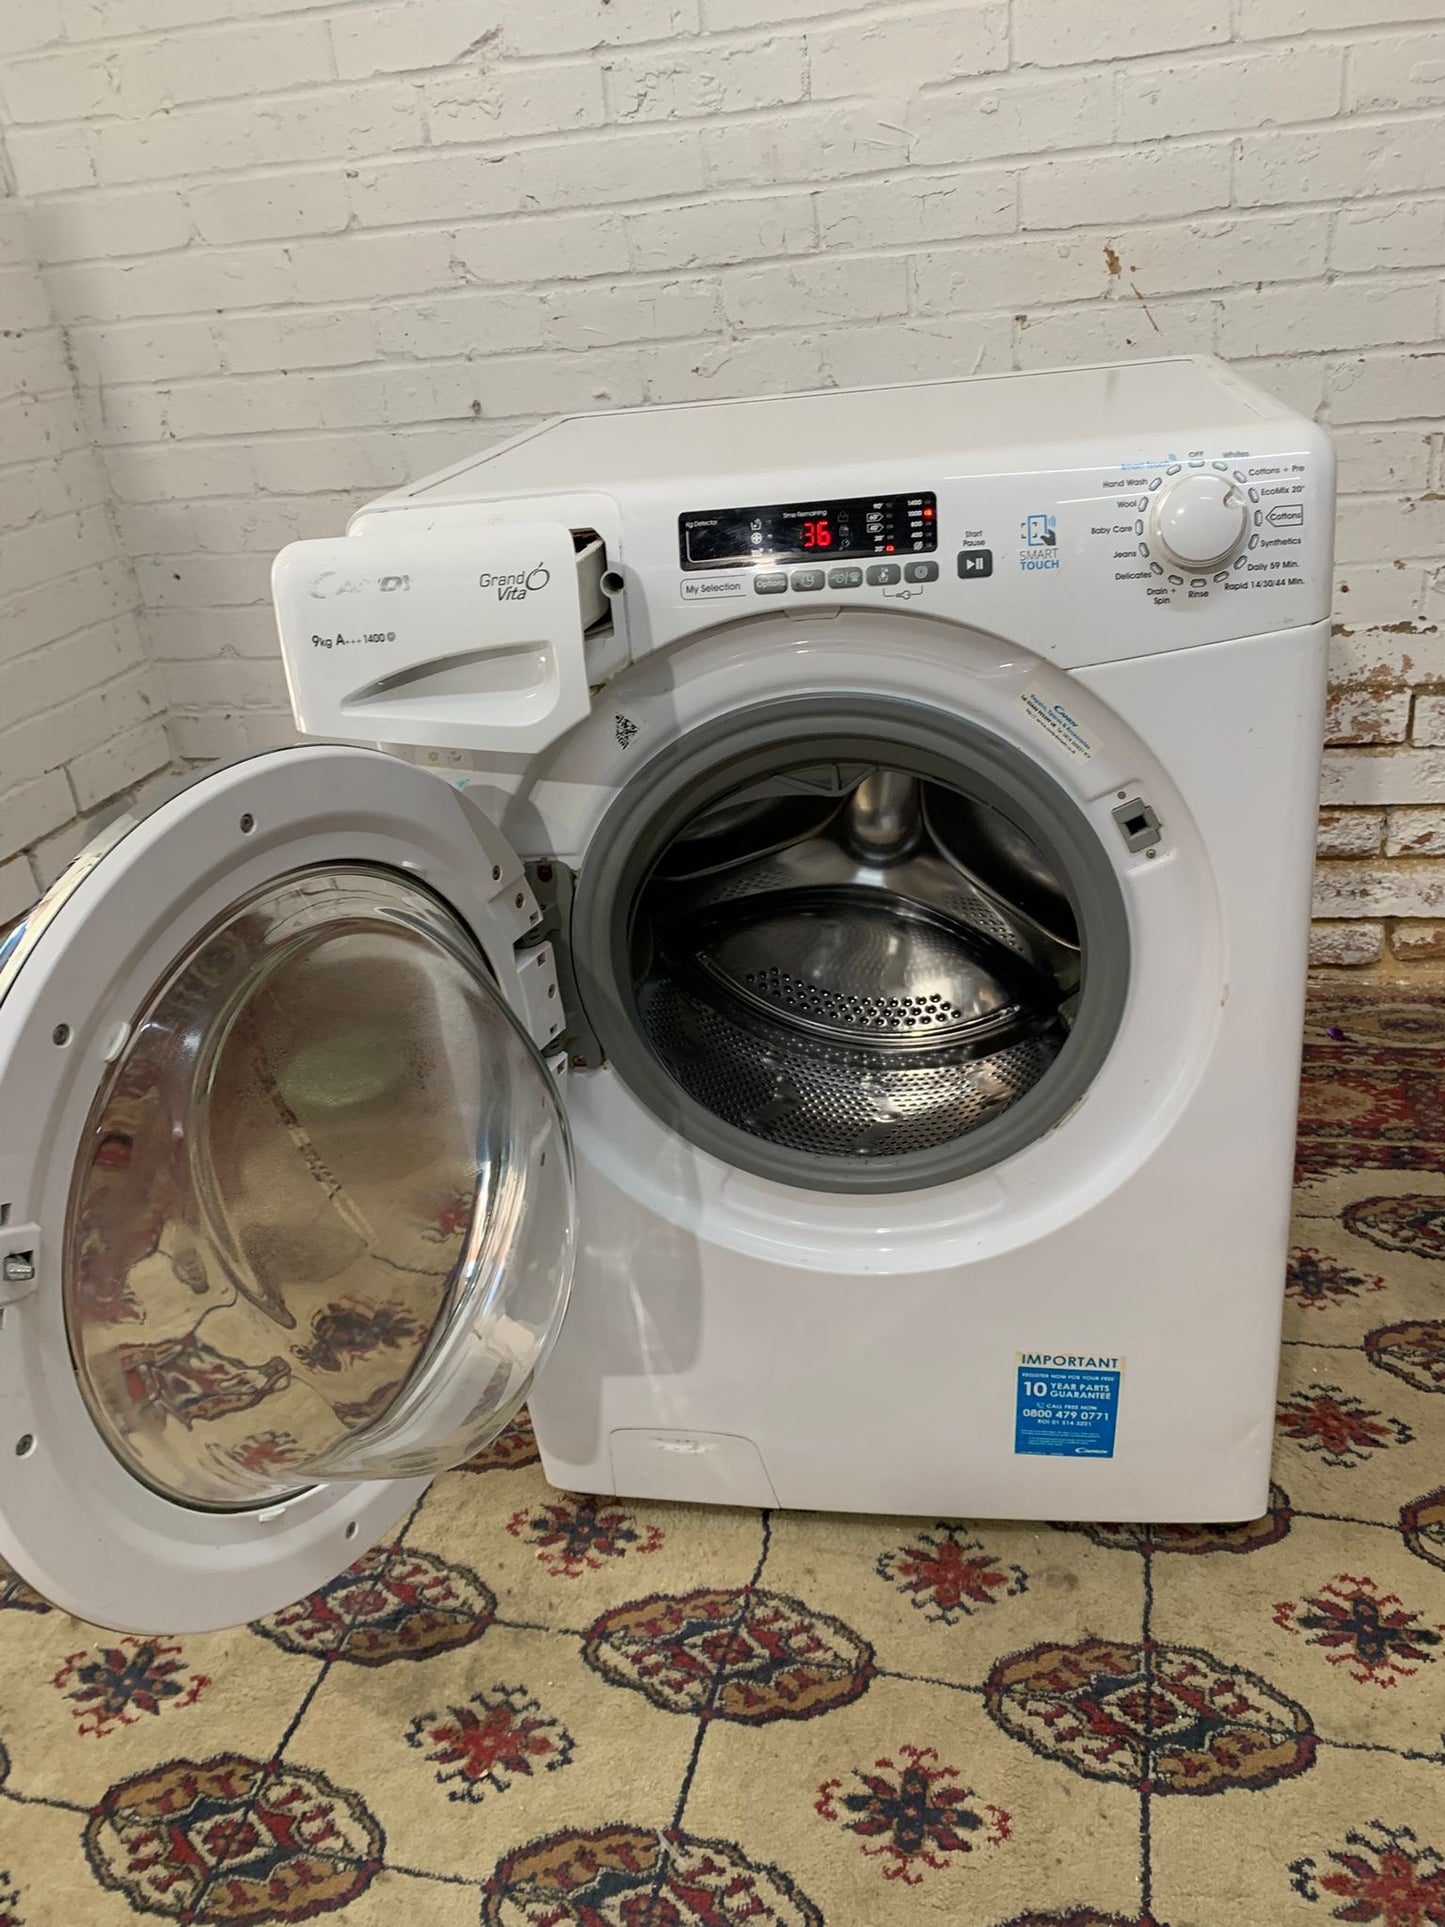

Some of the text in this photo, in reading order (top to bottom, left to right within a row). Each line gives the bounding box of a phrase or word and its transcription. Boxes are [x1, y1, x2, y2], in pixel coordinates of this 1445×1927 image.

[1248, 467, 1280, 476] Cottons
[1103, 478, 1148, 488] Hand Wash
[1260, 486, 1289, 496] EcoMix
[1117, 500, 1137, 508] Wool
[797, 510, 828, 518] Remaining
[1270, 512, 1302, 521] Cottons
[803, 521, 832, 548] 36
[1091, 527, 1111, 535] Baby
[1260, 538, 1302, 548] Synthetics
[1020, 548, 1059, 560] SMART
[1020, 560, 1059, 570] TOUCH
[1247, 560, 1300, 572] Daily 59 Min.
[1115, 572, 1152, 580] Delicates
[686, 583, 741, 595] My Selection
[756, 580, 786, 588] Options
[1224, 582, 1248, 591] Rapid
[1251, 579, 1286, 588] 14/30/44
[498, 586, 527, 601] Vita
[1146, 588, 1168, 596] Drain
[1188, 590, 1209, 598] Rinse
[1153, 597, 1171, 605] Spin
[312, 635, 332, 649] 9kg
[363, 633, 385, 643] 1400
[1021, 1354, 1118, 1368] IMPORTANT
[1024, 1381, 1110, 1397] 10 YEAR PARTS
[1050, 1390, 1111, 1400] GUARANTEE
[1023, 1409, 1108, 1421] 0800 479 0771
